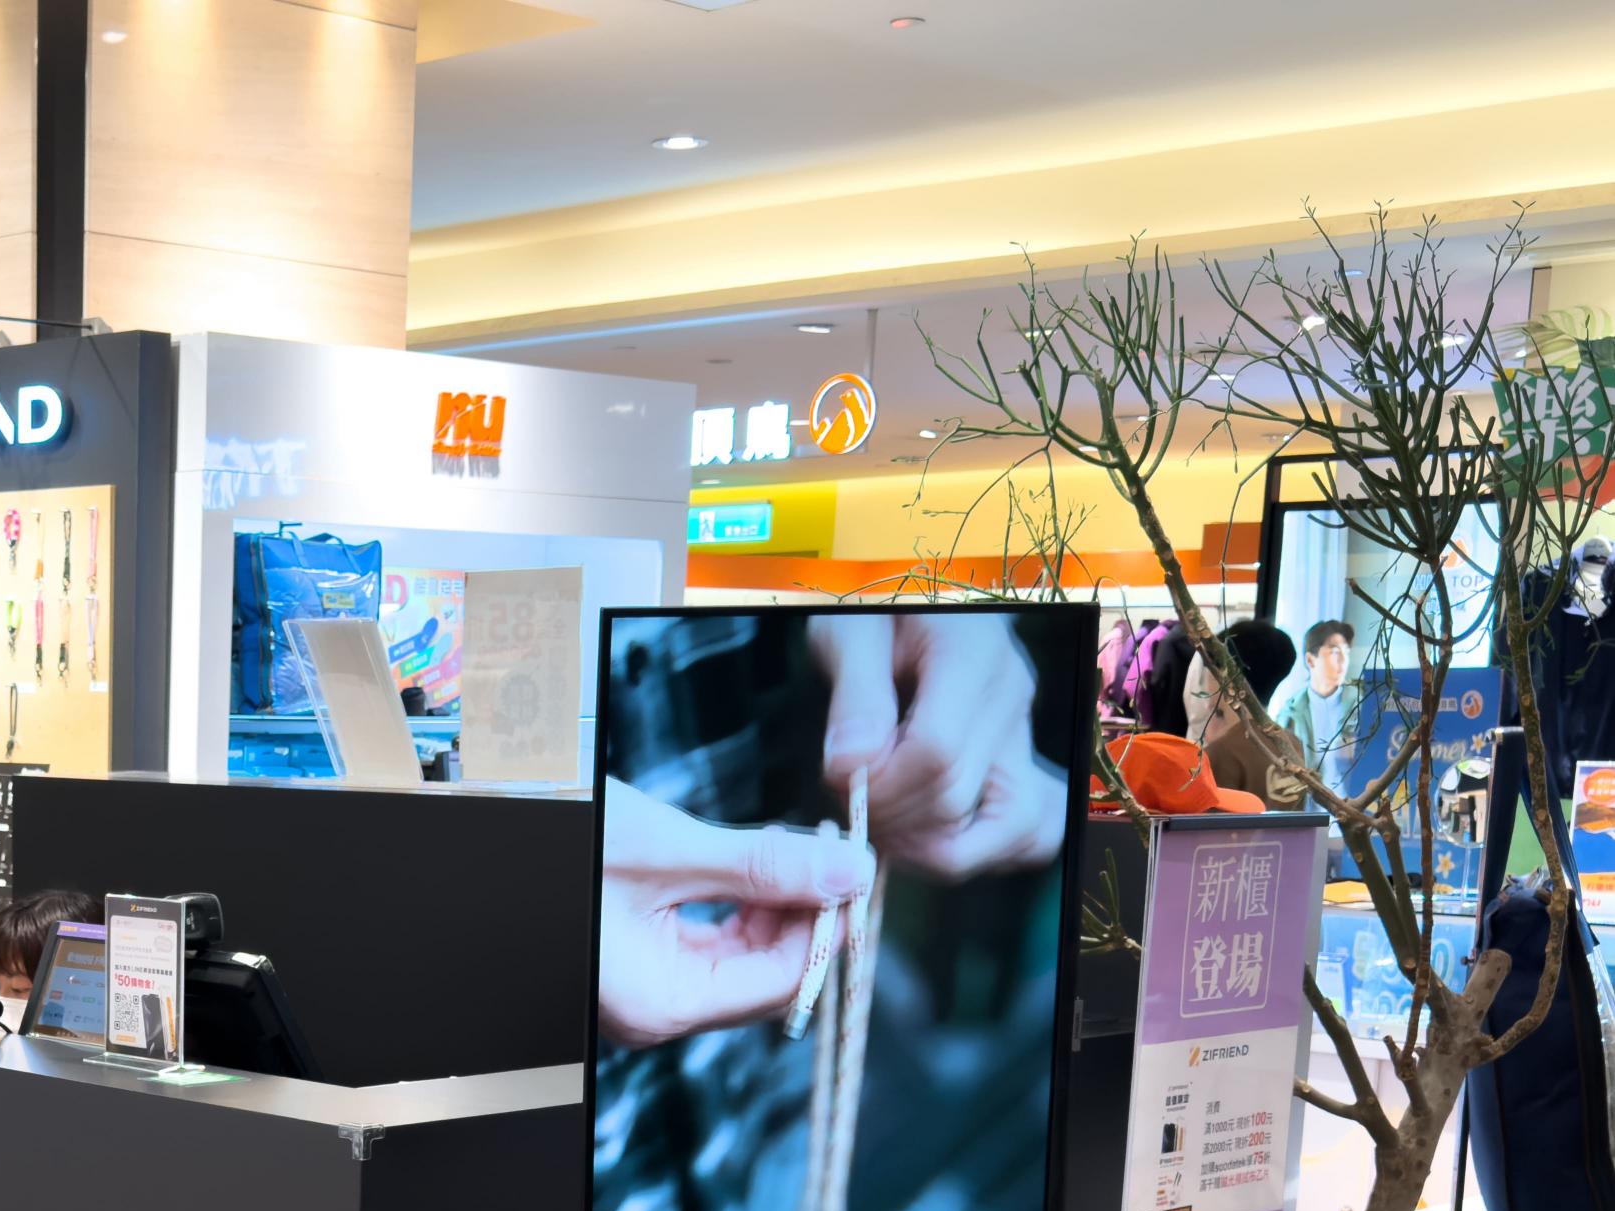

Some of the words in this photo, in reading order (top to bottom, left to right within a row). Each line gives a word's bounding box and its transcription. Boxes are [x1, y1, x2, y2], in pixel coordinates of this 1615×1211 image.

[1194, 851, 1274, 923] 新櫃
[1186, 930, 1264, 1002] 登場
[1202, 1044, 1249, 1062] ZIFRIEND
